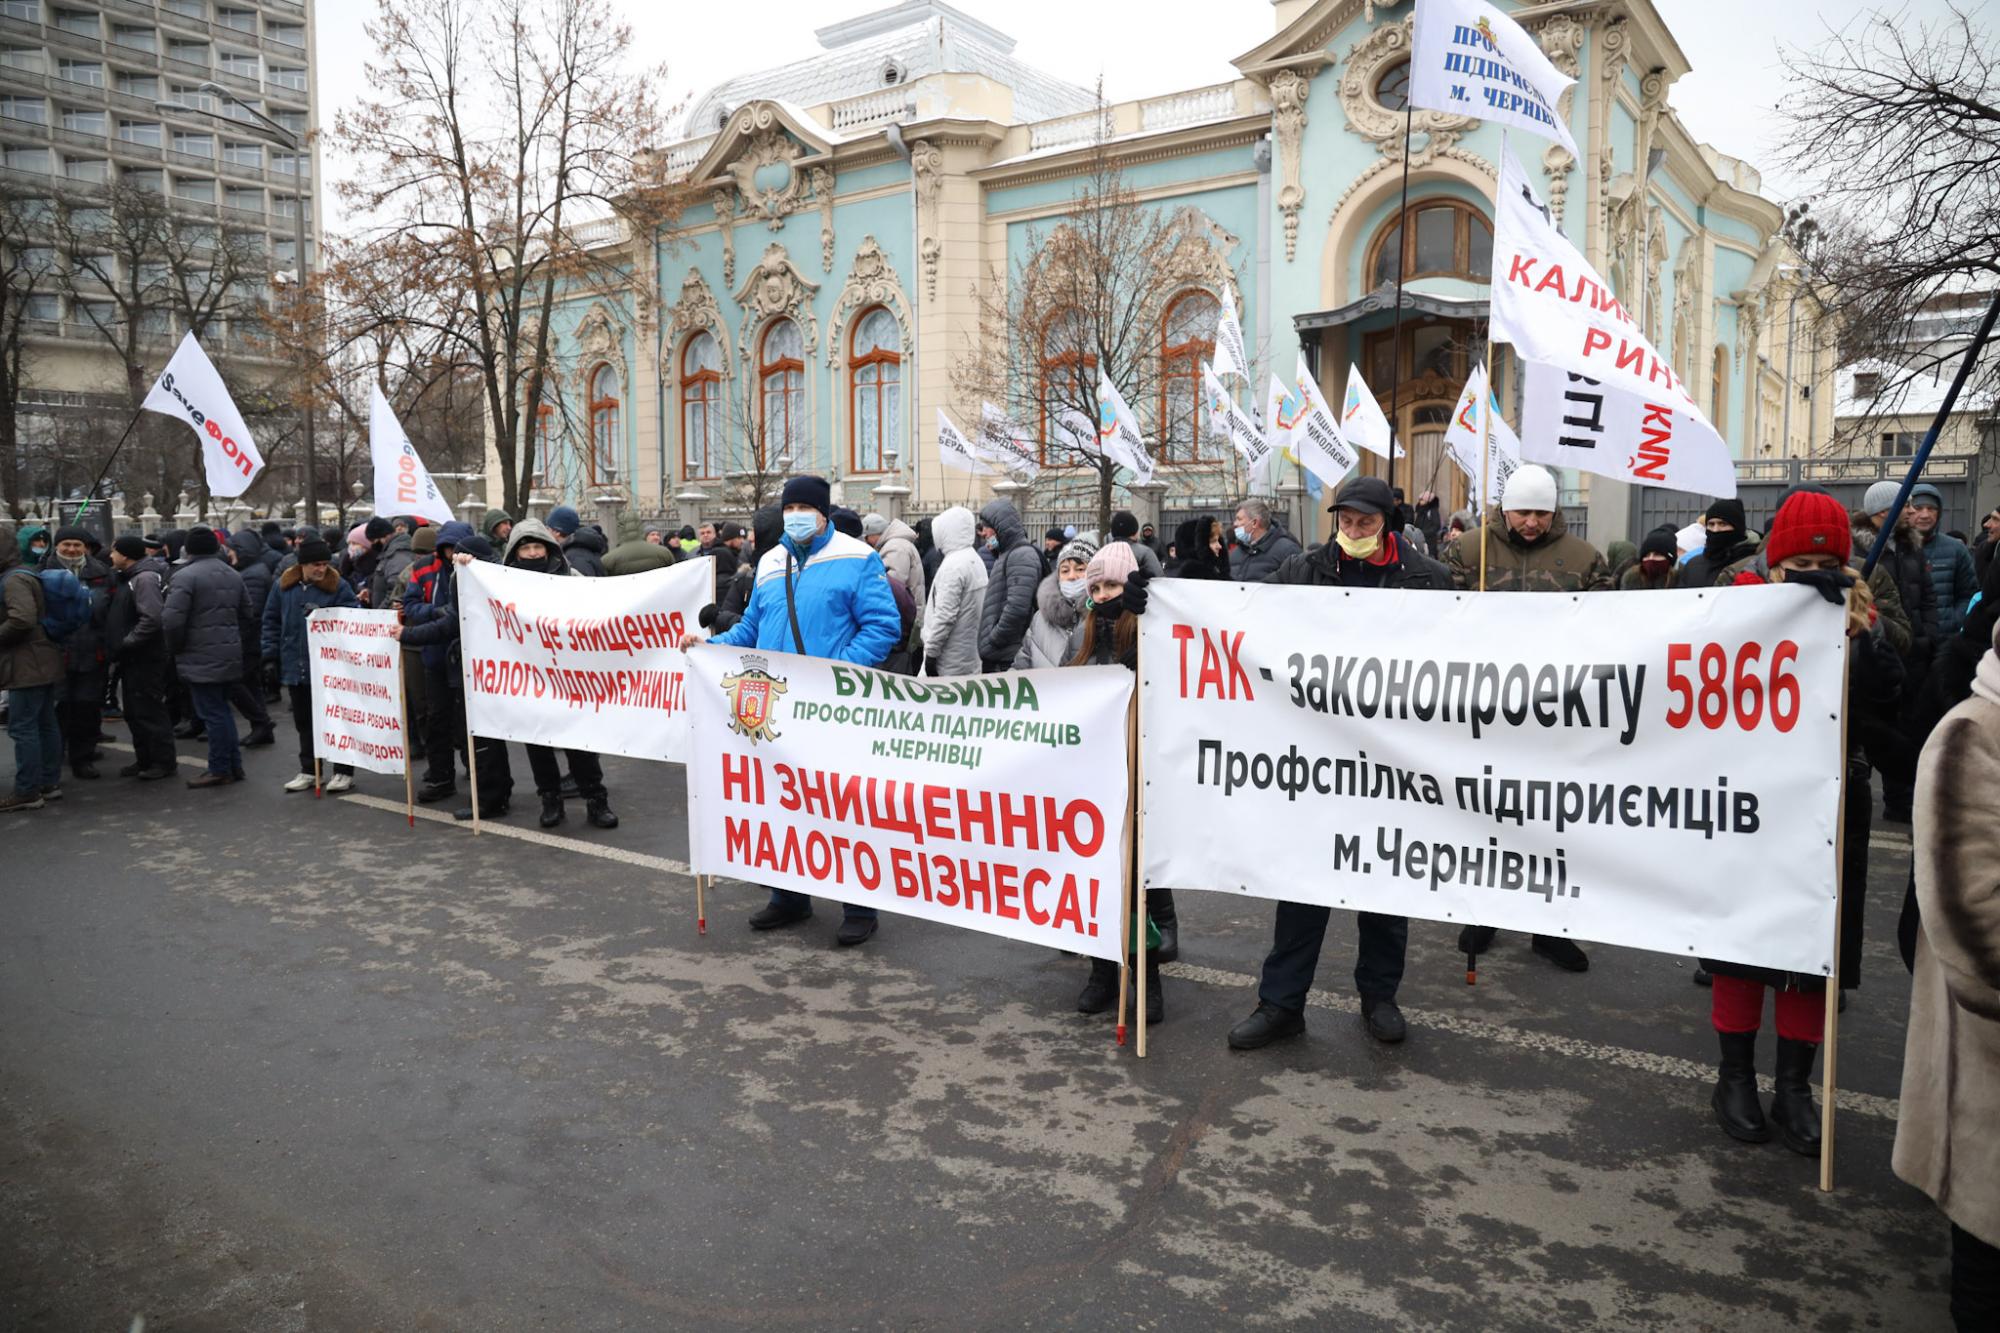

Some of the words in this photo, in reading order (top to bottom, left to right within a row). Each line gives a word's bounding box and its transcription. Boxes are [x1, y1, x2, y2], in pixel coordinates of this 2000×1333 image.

[1450, 84, 1471, 102] М.
[1583, 327, 1695, 404] РИН
[162, 372, 254, 477] SaveФОП
[939, 436, 967, 455] БЕРД
[535, 615, 563, 655] це
[566, 610, 685, 657] знищення
[472, 658, 546, 698] малого
[831, 665, 1040, 711] БУКОВИНА
[1172, 623, 1255, 702] ТАК
[1259, 667, 1274, 682] -
[1287, 651, 1647, 746] законопроекту
[1665, 639, 1800, 734] 5866
[326, 704, 340, 718] НЕ
[793, 701, 925, 733] ПРОФСПІЛКА
[931, 714, 1082, 748] ПІДПРИЄМЦІВ
[872, 739, 983, 769] м.ЧЕРНІВЦІ
[722, 752, 765, 805] НІ
[775, 763, 1106, 859] ЗНИЩЕННЮ
[1197, 739, 1444, 807] Профспілка
[1455, 765, 1760, 840] підприємців
[725, 816, 882, 891] МАЛОГО
[890, 847, 1100, 938] БІЗНЕСА!
[1334, 826, 1581, 903] м.Чернівці.
